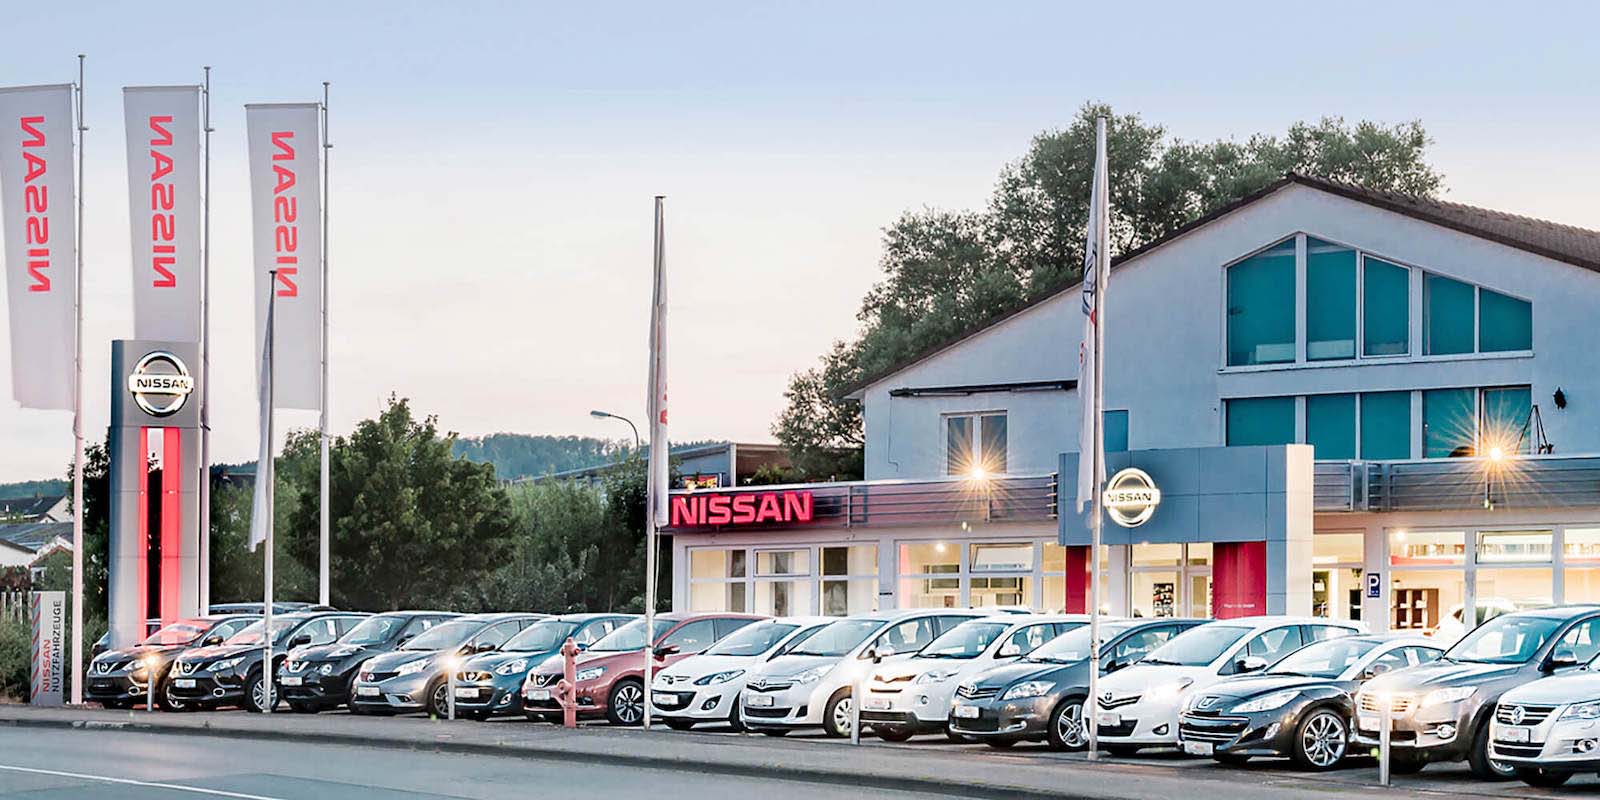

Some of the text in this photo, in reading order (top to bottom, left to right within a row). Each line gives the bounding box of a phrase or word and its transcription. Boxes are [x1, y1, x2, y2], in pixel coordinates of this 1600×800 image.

[136, 378, 189, 389] NISSAN
[671, 491, 814, 527] NISSAN
[1368, 575, 1380, 596] P
[52, 600, 62, 693] NUTZFAHRZEUGE
[42, 639, 51, 693] NISSAN
